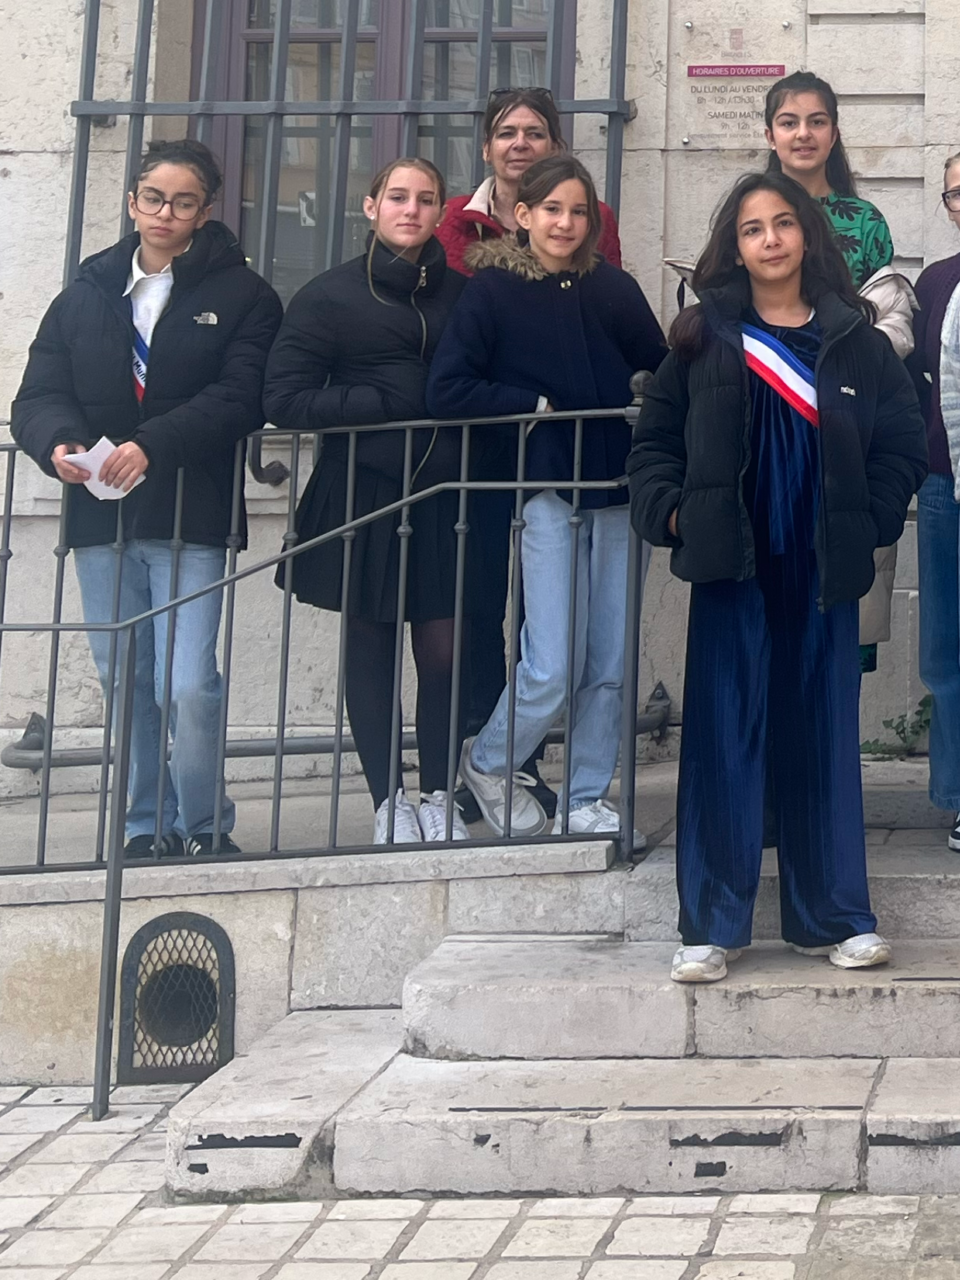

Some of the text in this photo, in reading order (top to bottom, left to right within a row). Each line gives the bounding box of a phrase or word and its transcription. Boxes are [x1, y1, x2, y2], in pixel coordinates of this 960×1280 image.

[692, 67, 780, 75] HORAIRES D'OUVERTURE
[690, 85, 702, 93] DU
[704, 85, 728, 93] LUNDI
[729, 85, 740, 93] AU
[707, 111, 764, 119] SAMEDI MATIN
